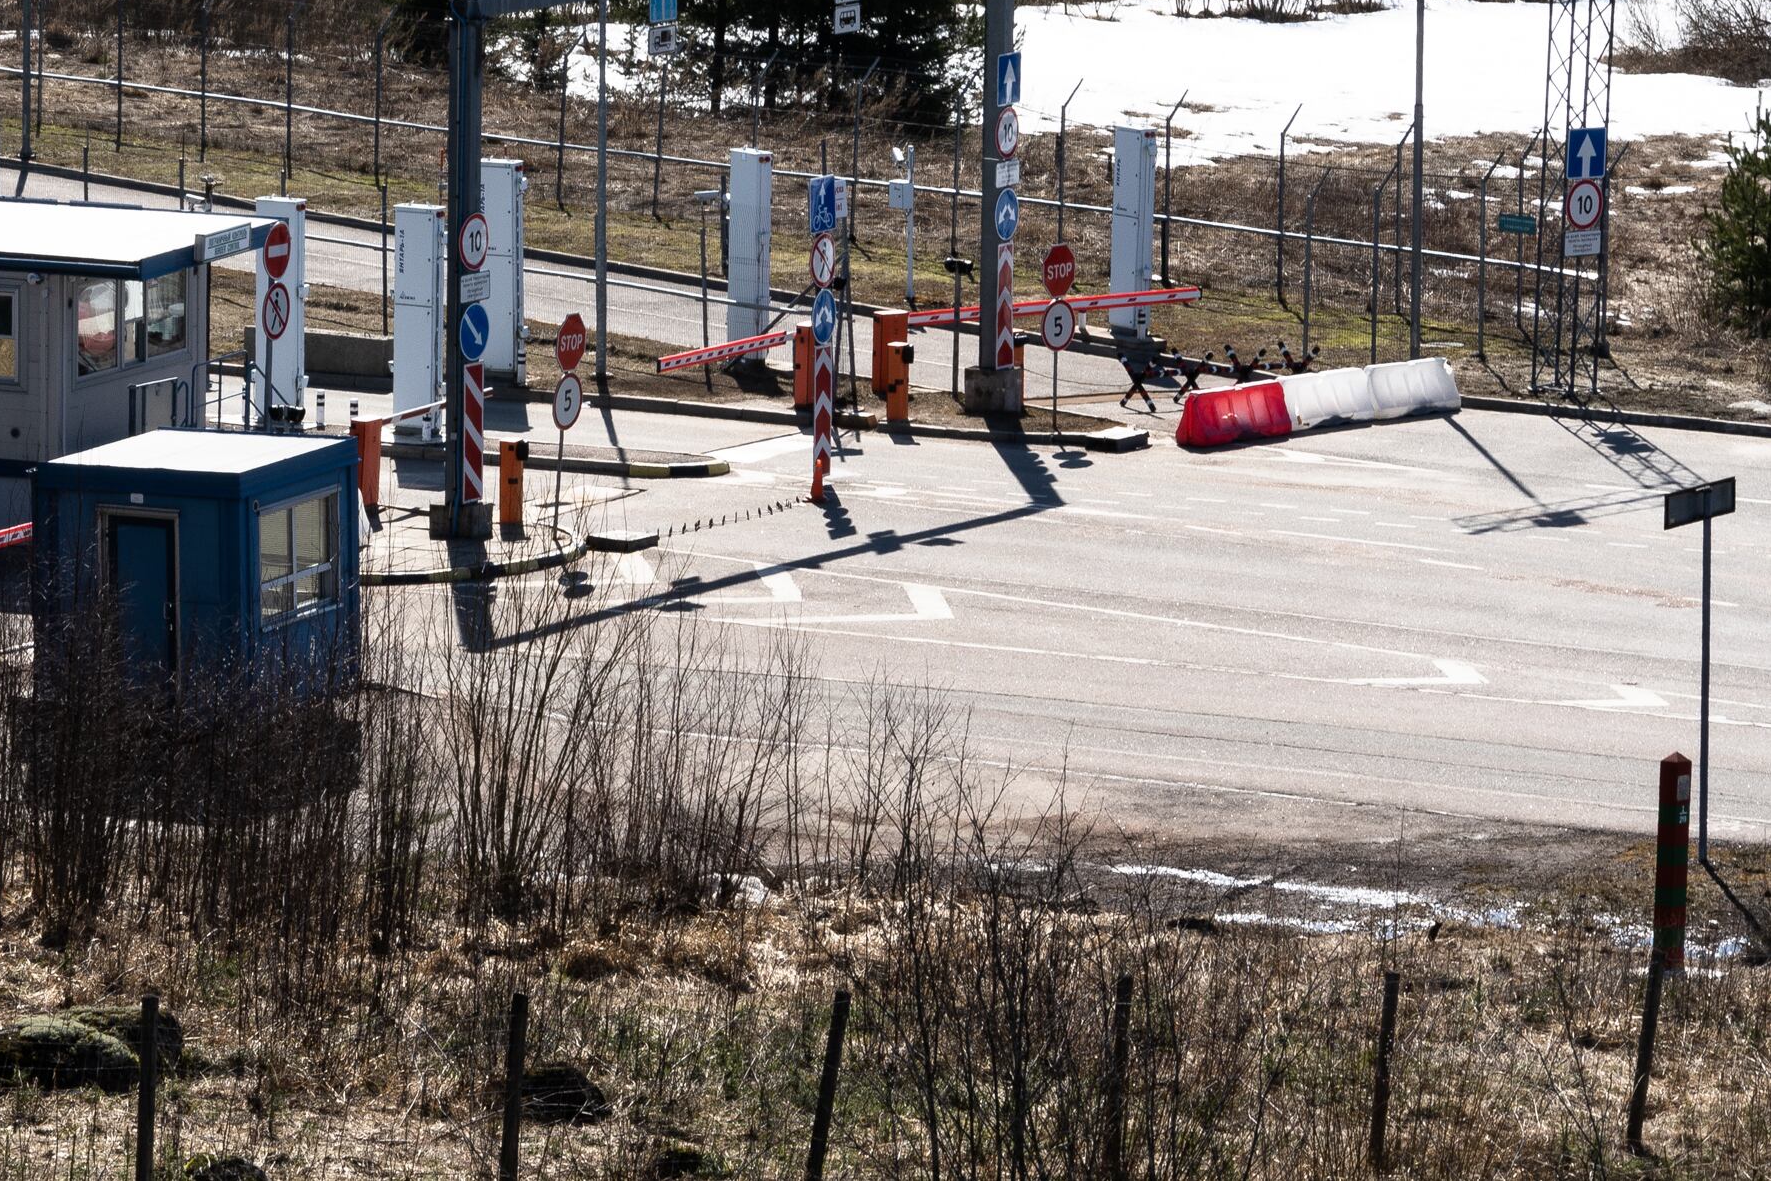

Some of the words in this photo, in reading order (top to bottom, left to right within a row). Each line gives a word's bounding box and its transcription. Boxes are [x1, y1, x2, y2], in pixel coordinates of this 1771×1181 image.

[1004, 122, 1013, 143] 10
[1577, 194, 1593, 215] 10
[469, 229, 482, 253] 10
[1047, 261, 1073, 281] STOP
[1053, 316, 1064, 337] 5
[560, 333, 583, 352] STOP
[563, 388, 573, 412] 5
